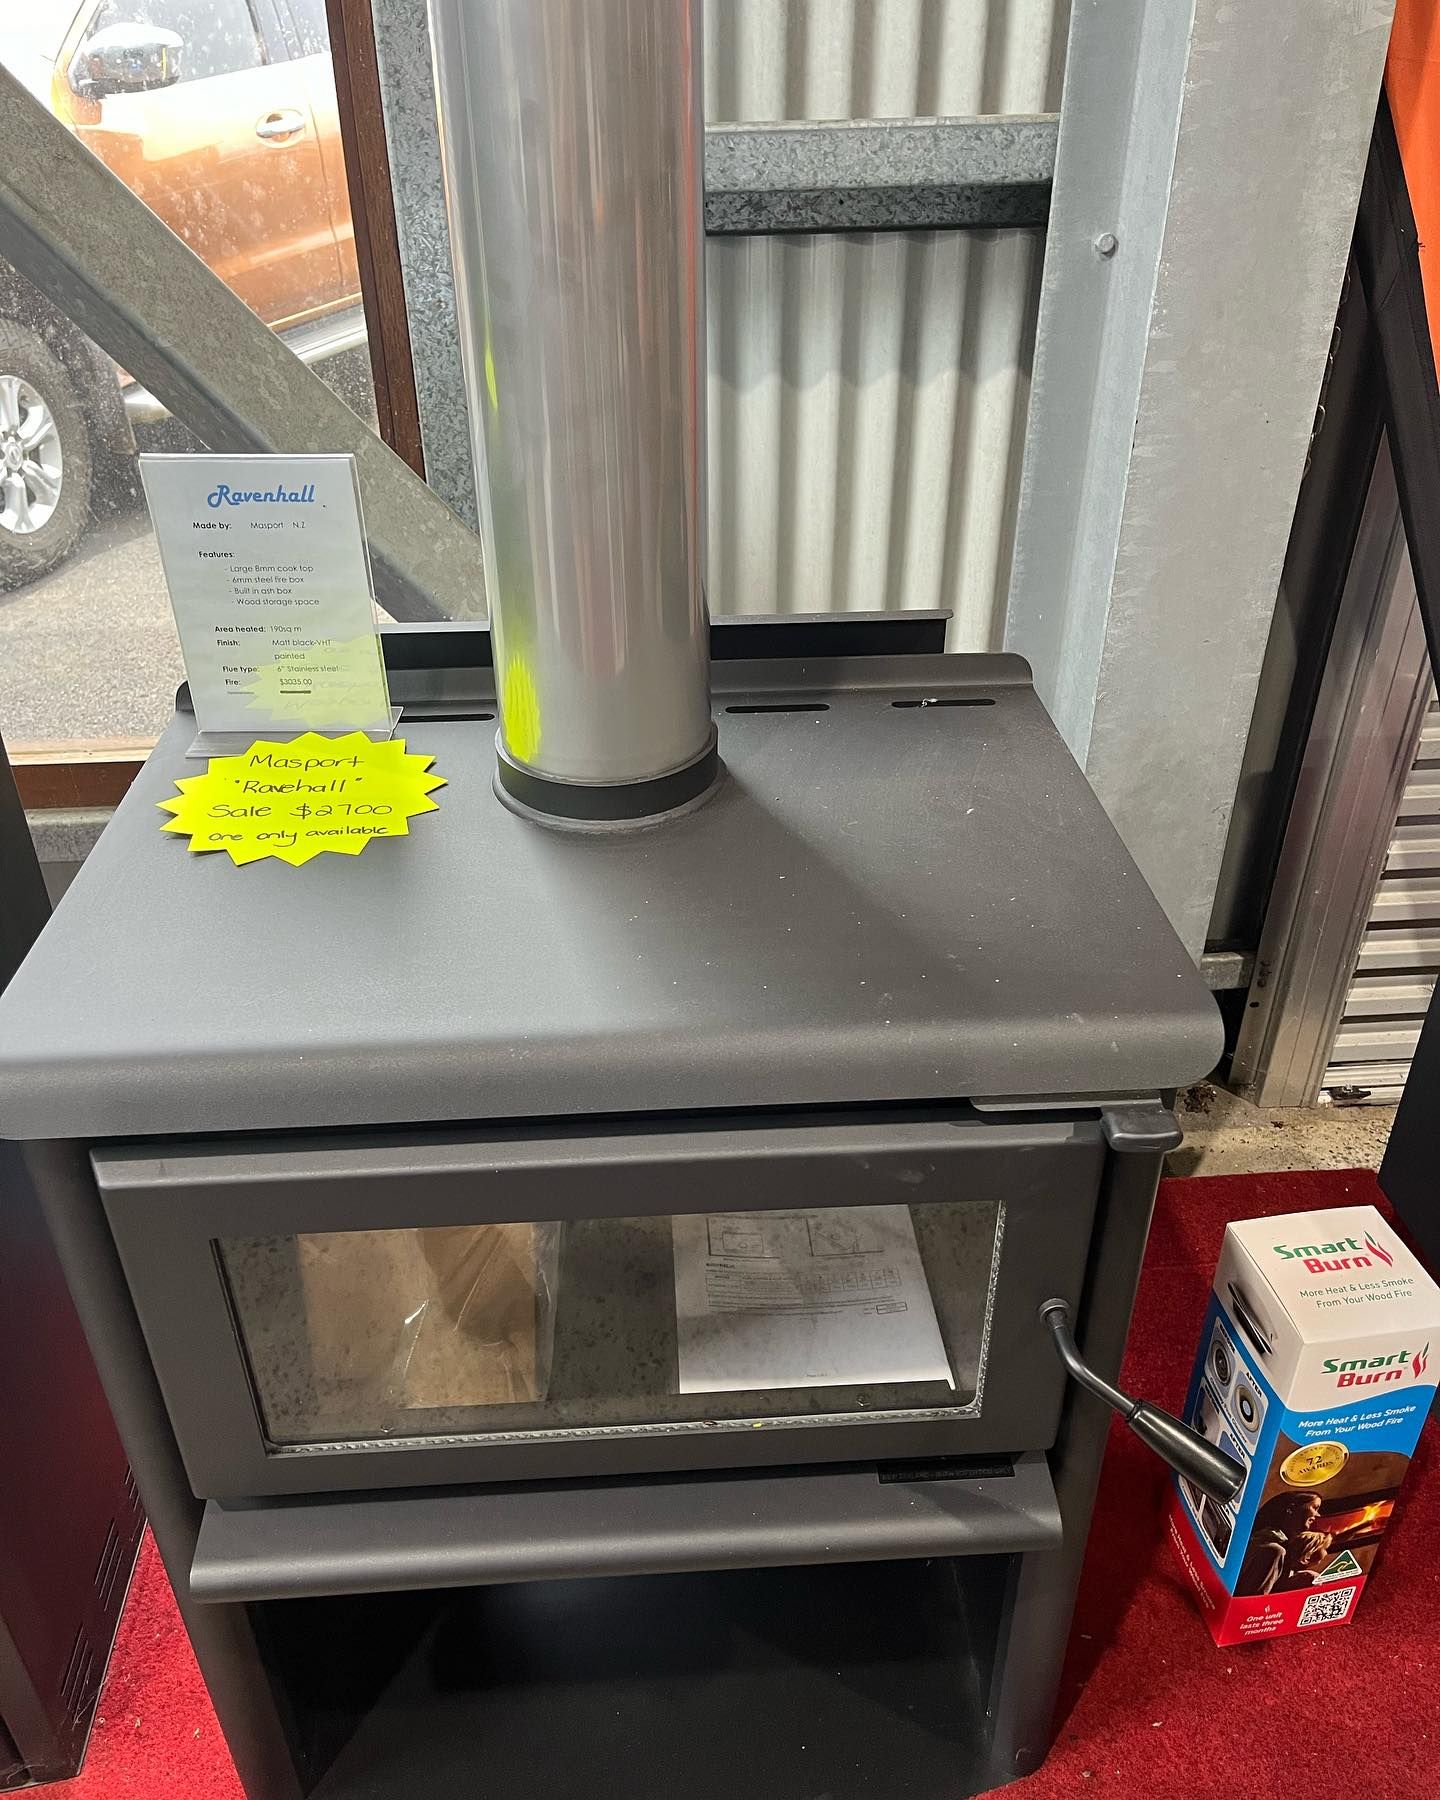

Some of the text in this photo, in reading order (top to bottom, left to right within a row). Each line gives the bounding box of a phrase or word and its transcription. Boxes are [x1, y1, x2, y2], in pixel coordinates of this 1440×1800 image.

[207, 484, 315, 508] Ravenhall
[192, 521, 217, 530] Made
[218, 521, 232, 530] by:
[250, 522, 284, 530] Masport
[198, 551, 235, 559] Features:
[230, 565, 253, 574] Large
[300, 565, 314, 573] top
[232, 576, 252, 584] 6mm
[262, 598, 292, 606] storage
[274, 653, 305, 661] painted
[240, 666, 260, 674] type:
[280, 678, 312, 686] $3035.00
[250, 754, 365, 771] Masport
[207, 803, 393, 820] Sale $2700
[209, 826, 389, 847] one only available
[1273, 1238, 1363, 1260] Smart
[1303, 1256, 1373, 1274] Burn
[1300, 1278, 1414, 1298] More Heat & Less Smoke
[1316, 1289, 1412, 1308] From Your Wood Fire
[1321, 1350, 1411, 1374] Smart
[1246, 1372, 1262, 1398] AFTER
[1337, 1370, 1402, 1388] Burn
[1298, 1420, 1323, 1428] More
[1325, 1417, 1348, 1427] Heat
[1360, 1411, 1381, 1420] Less
[1384, 1405, 1416, 1416] Smoke
[1305, 1417, 1403, 1437] From Your Wood Fire
[1298, 1461, 1334, 1475] AWARDS
[1306, 1456, 1322, 1465] 72
[1265, 1612, 1282, 1620] unit
[1240, 1619, 1284, 1630] lasts three
[1244, 1626, 1276, 1635] months
